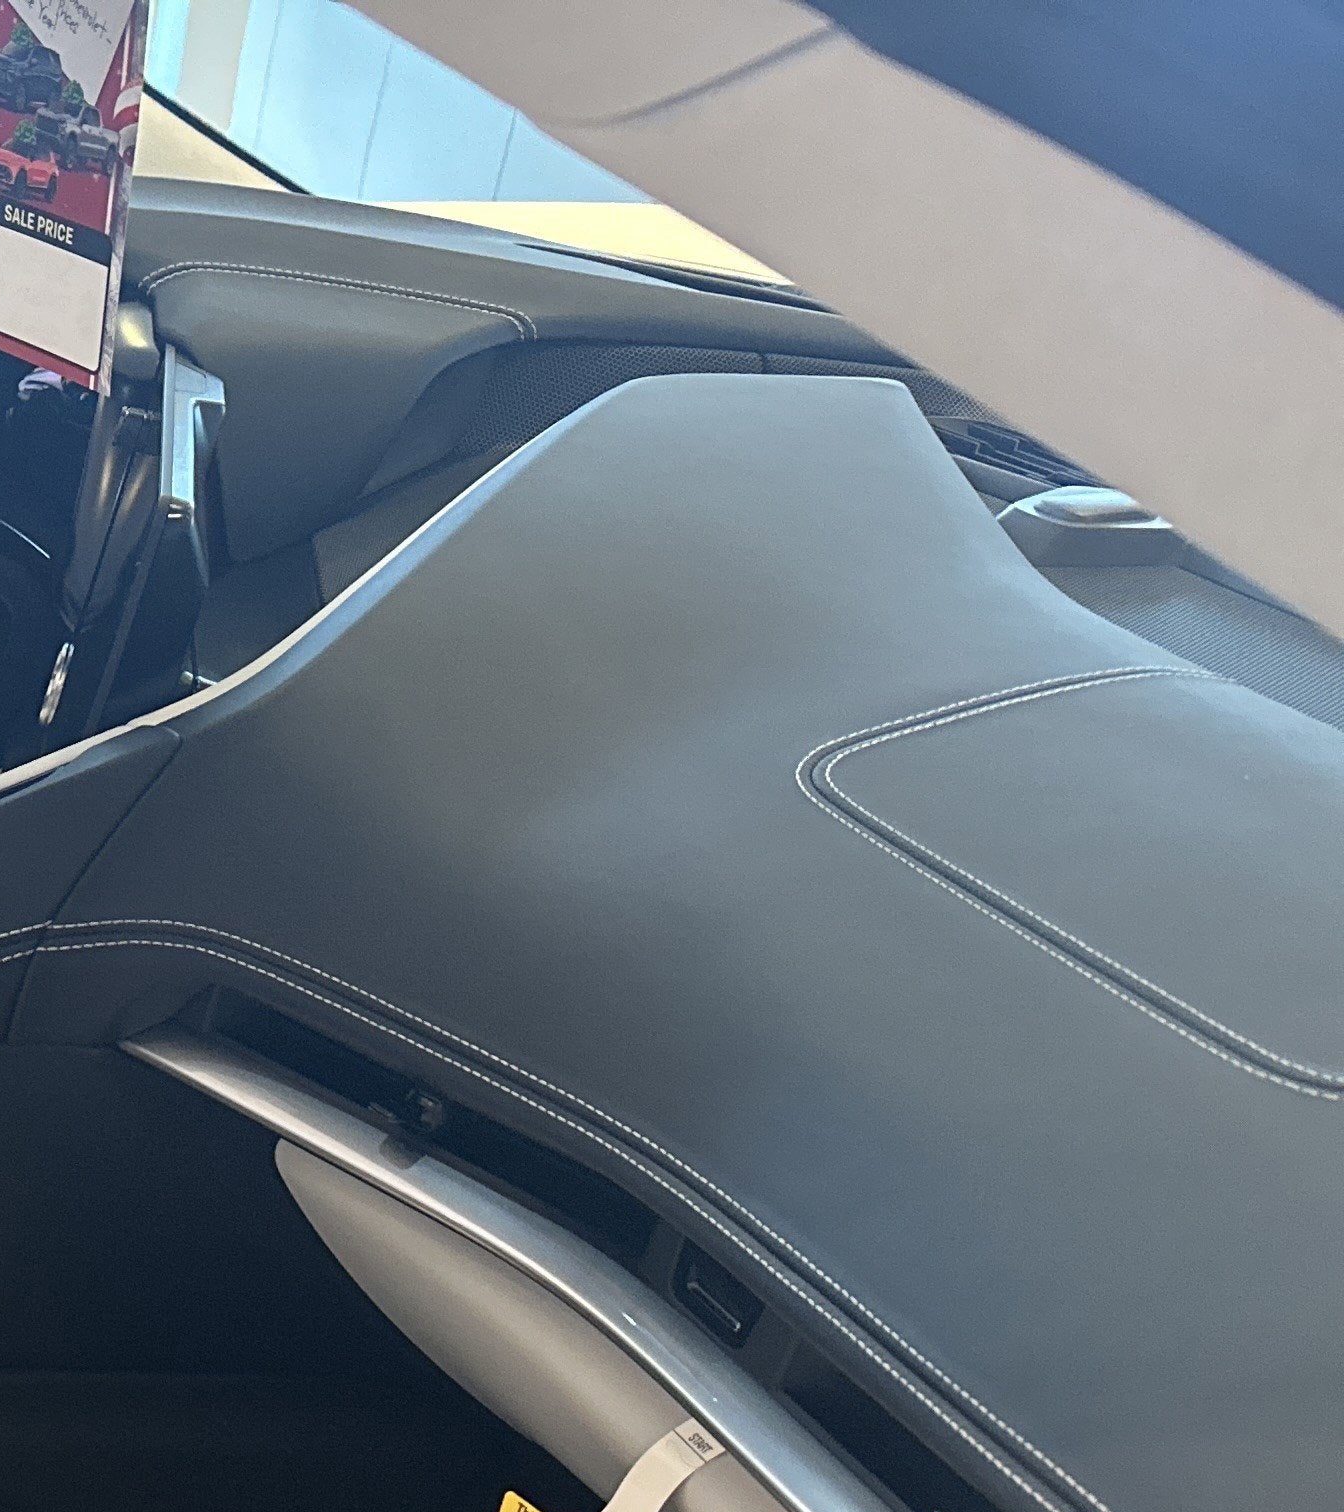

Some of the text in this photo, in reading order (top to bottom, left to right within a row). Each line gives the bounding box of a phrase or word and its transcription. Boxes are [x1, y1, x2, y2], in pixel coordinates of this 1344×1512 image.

[3, 204, 74, 245] SALE PRICE
[687, 1432, 714, 1453] START
